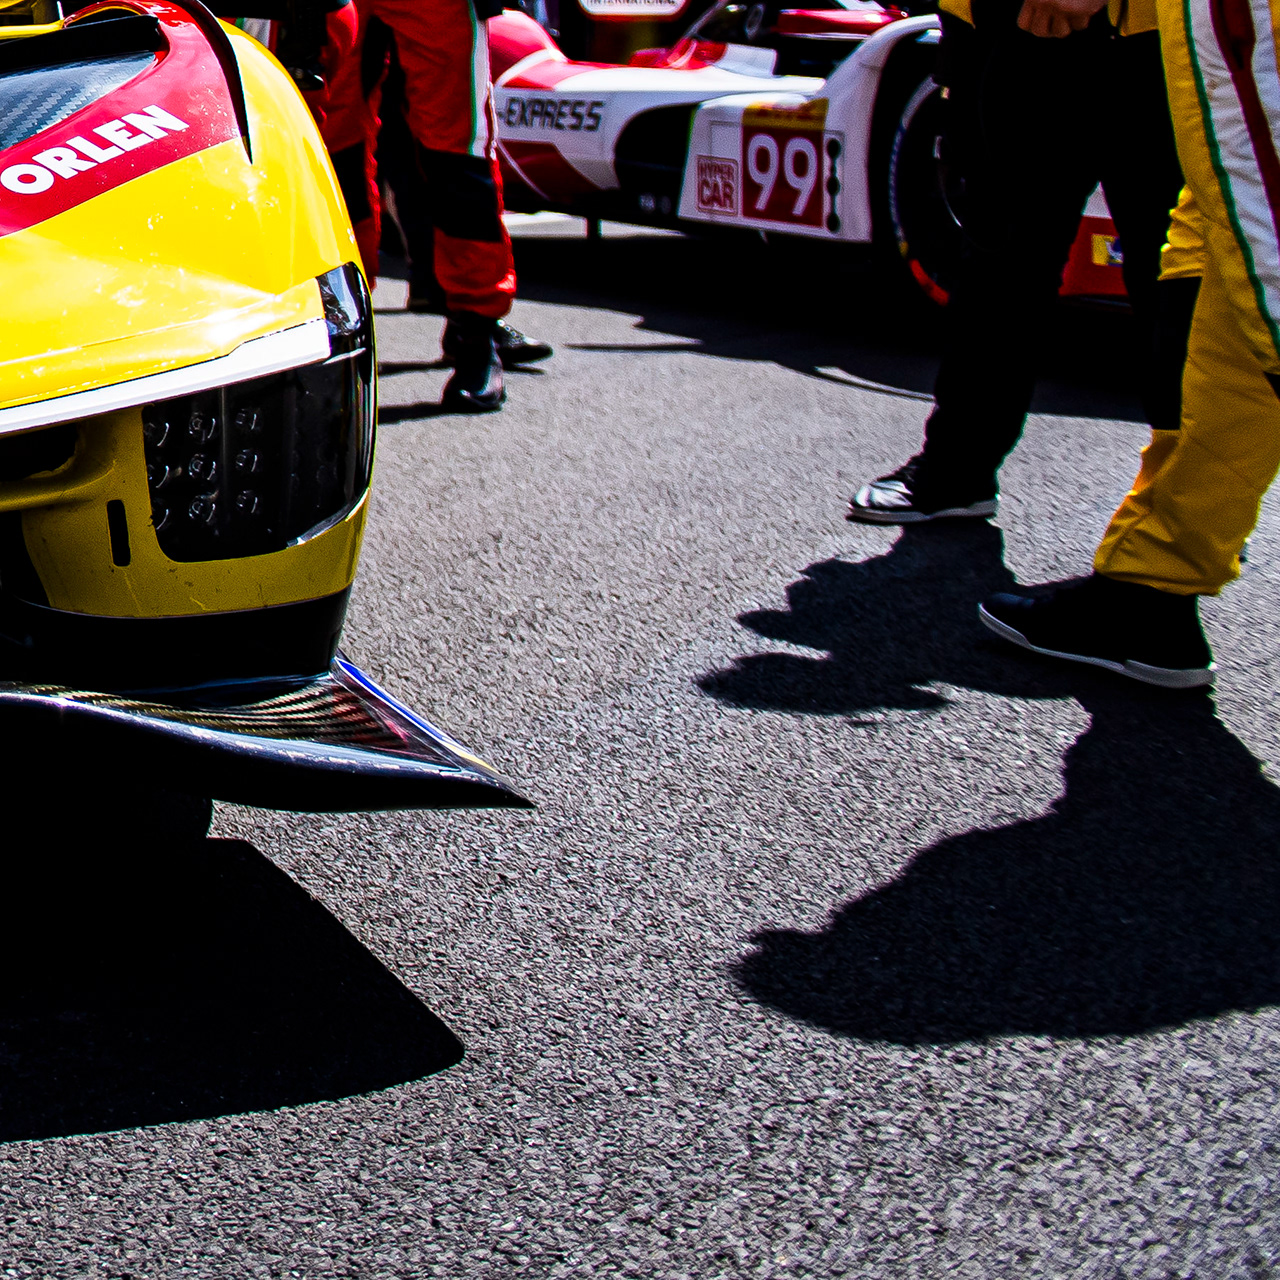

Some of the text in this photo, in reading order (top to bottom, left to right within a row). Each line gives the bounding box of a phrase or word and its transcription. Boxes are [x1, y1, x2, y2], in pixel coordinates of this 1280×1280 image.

[0, 104, 190, 195] ORLEN
[747, 132, 818, 217] 99
[699, 178, 734, 209] CAR
